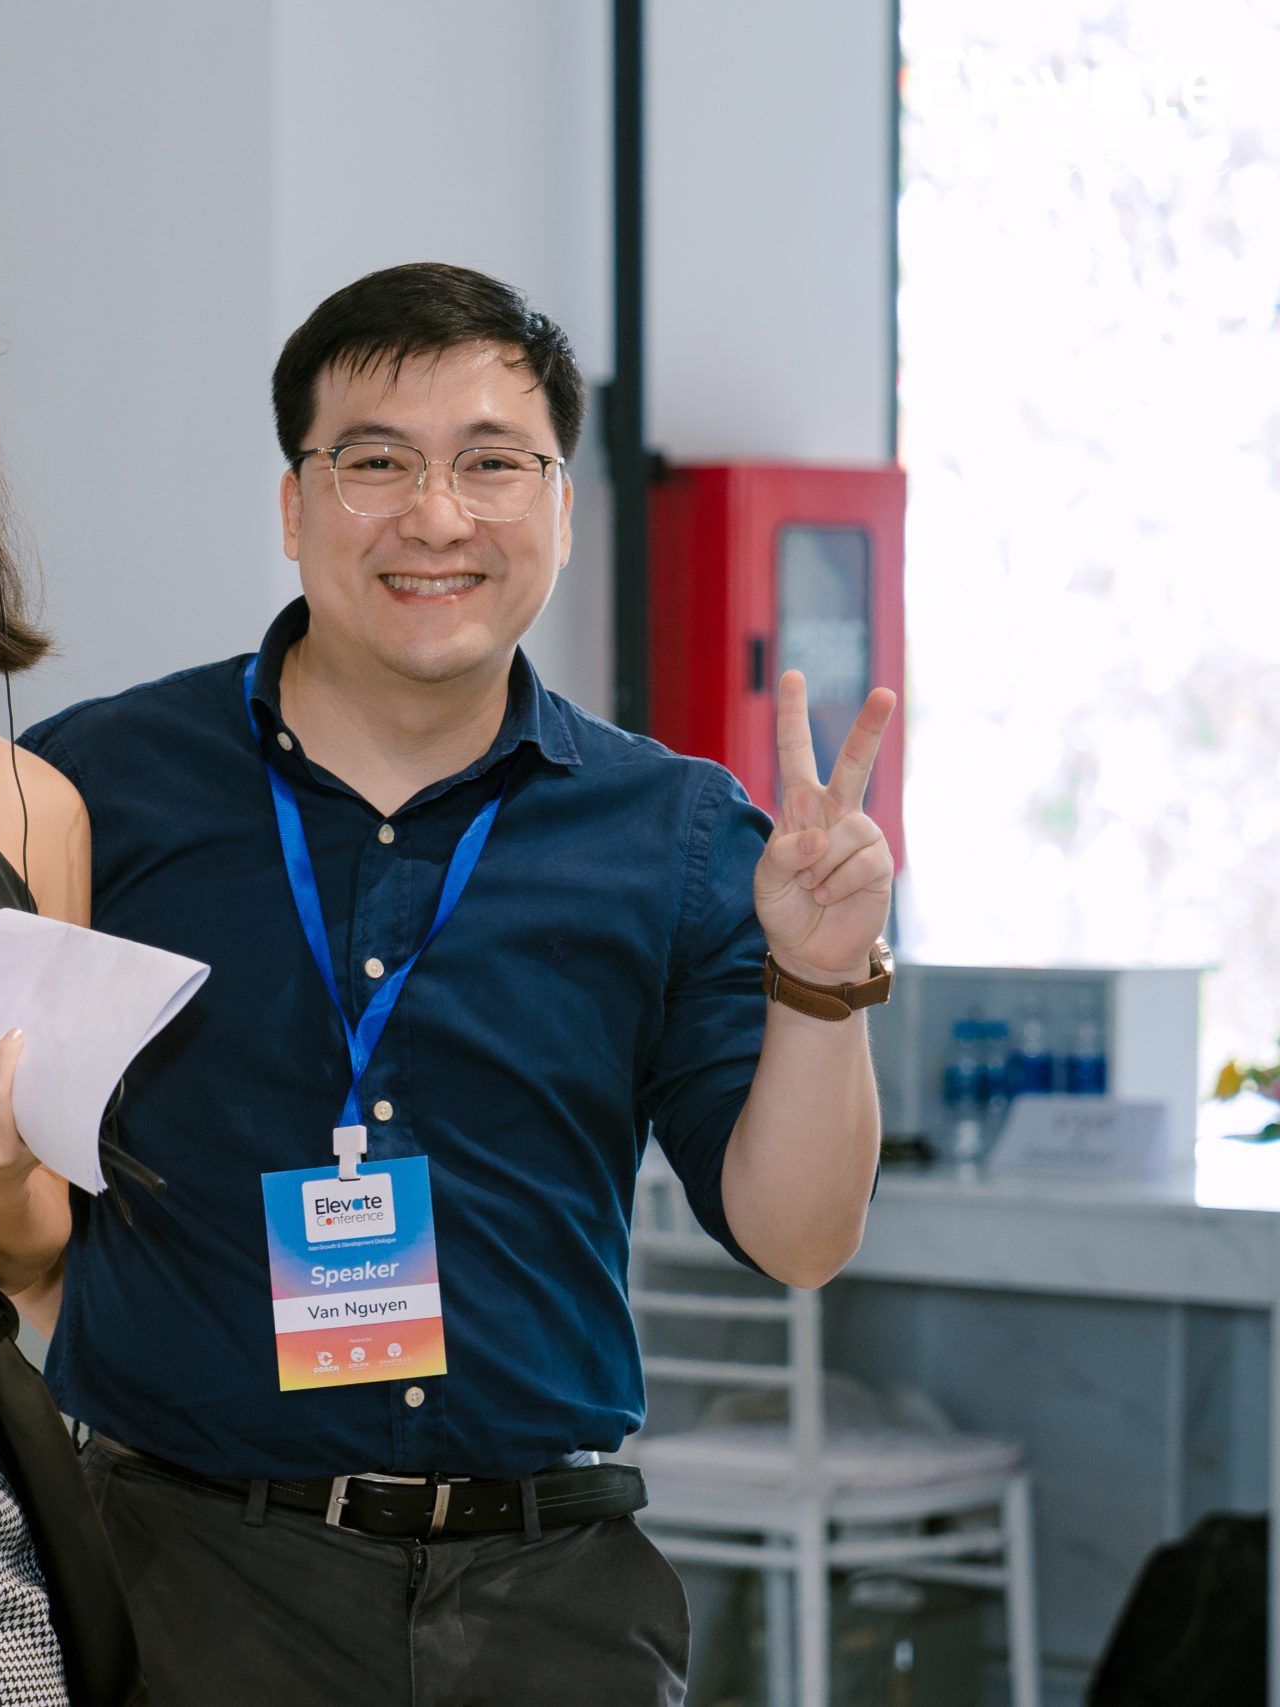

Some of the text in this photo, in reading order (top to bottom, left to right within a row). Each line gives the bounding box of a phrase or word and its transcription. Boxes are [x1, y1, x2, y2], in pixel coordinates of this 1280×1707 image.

[315, 1194, 383, 1216] Elevate
[316, 1210, 384, 1227] Conference
[311, 1261, 400, 1288] Speaker
[307, 1299, 407, 1320] Van Nguyen
